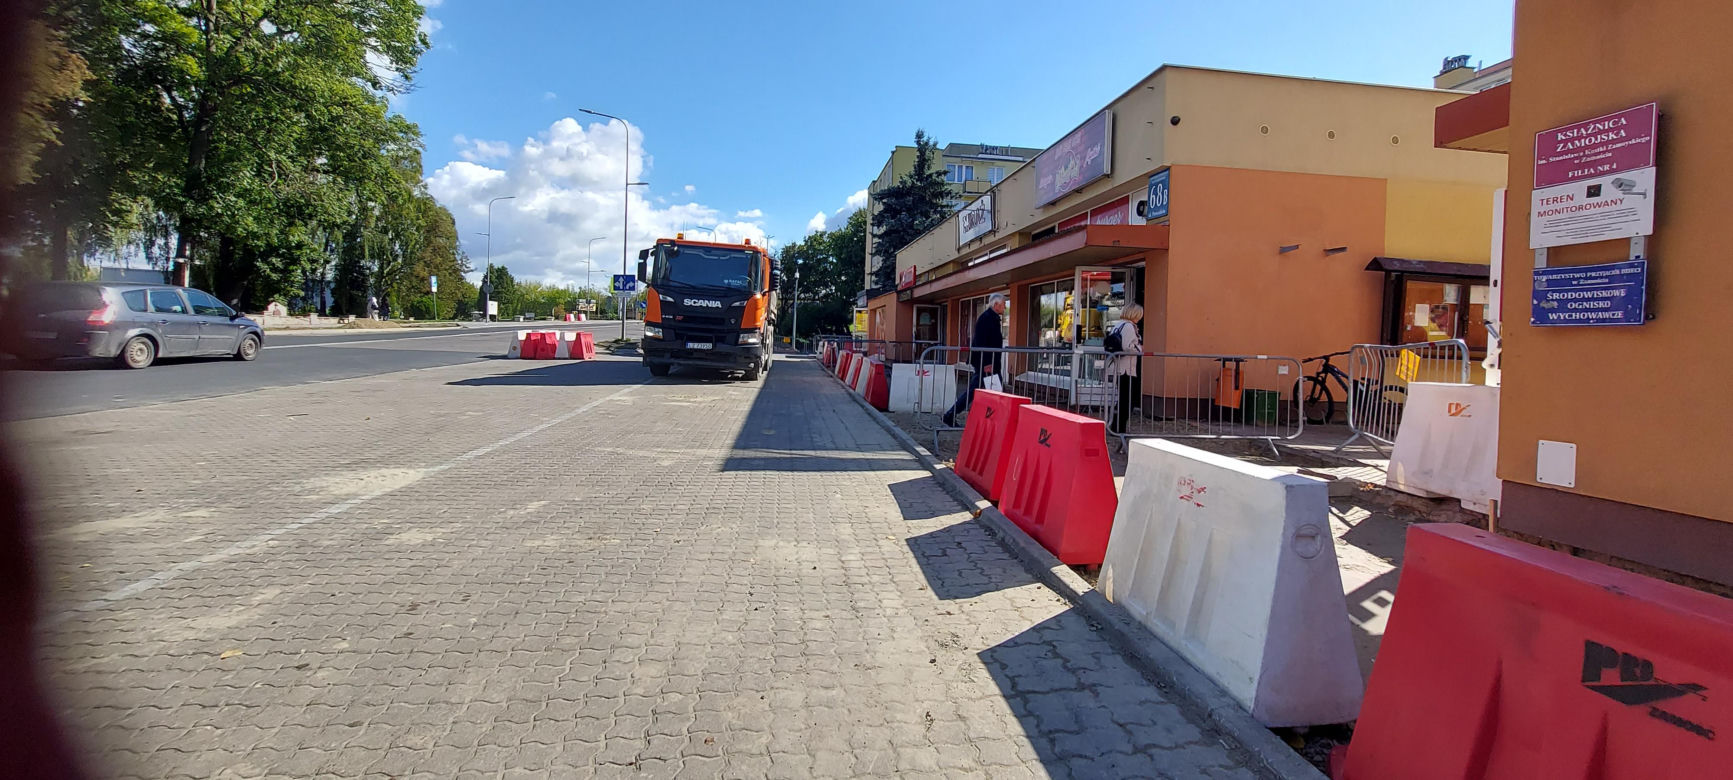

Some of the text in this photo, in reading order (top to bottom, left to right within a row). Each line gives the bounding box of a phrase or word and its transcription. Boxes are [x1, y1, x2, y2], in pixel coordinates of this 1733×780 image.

[1557, 117, 1627, 141] KSIĄŻNICA
[1556, 129, 1626, 152] ZAMOJSKA
[1568, 166, 1595, 178] FILIA
[1597, 165, 1610, 173] NR
[1539, 193, 1575, 207] TEREN
[1537, 198, 1625, 218] MONITOROWANY
[1547, 288, 1627, 300] ŚRODOWISKOWE
[683, 298, 722, 308] SCANIA
[1567, 301, 1611, 309] OGNISKO
[1548, 311, 1625, 320] WYCHOWAWCZE
